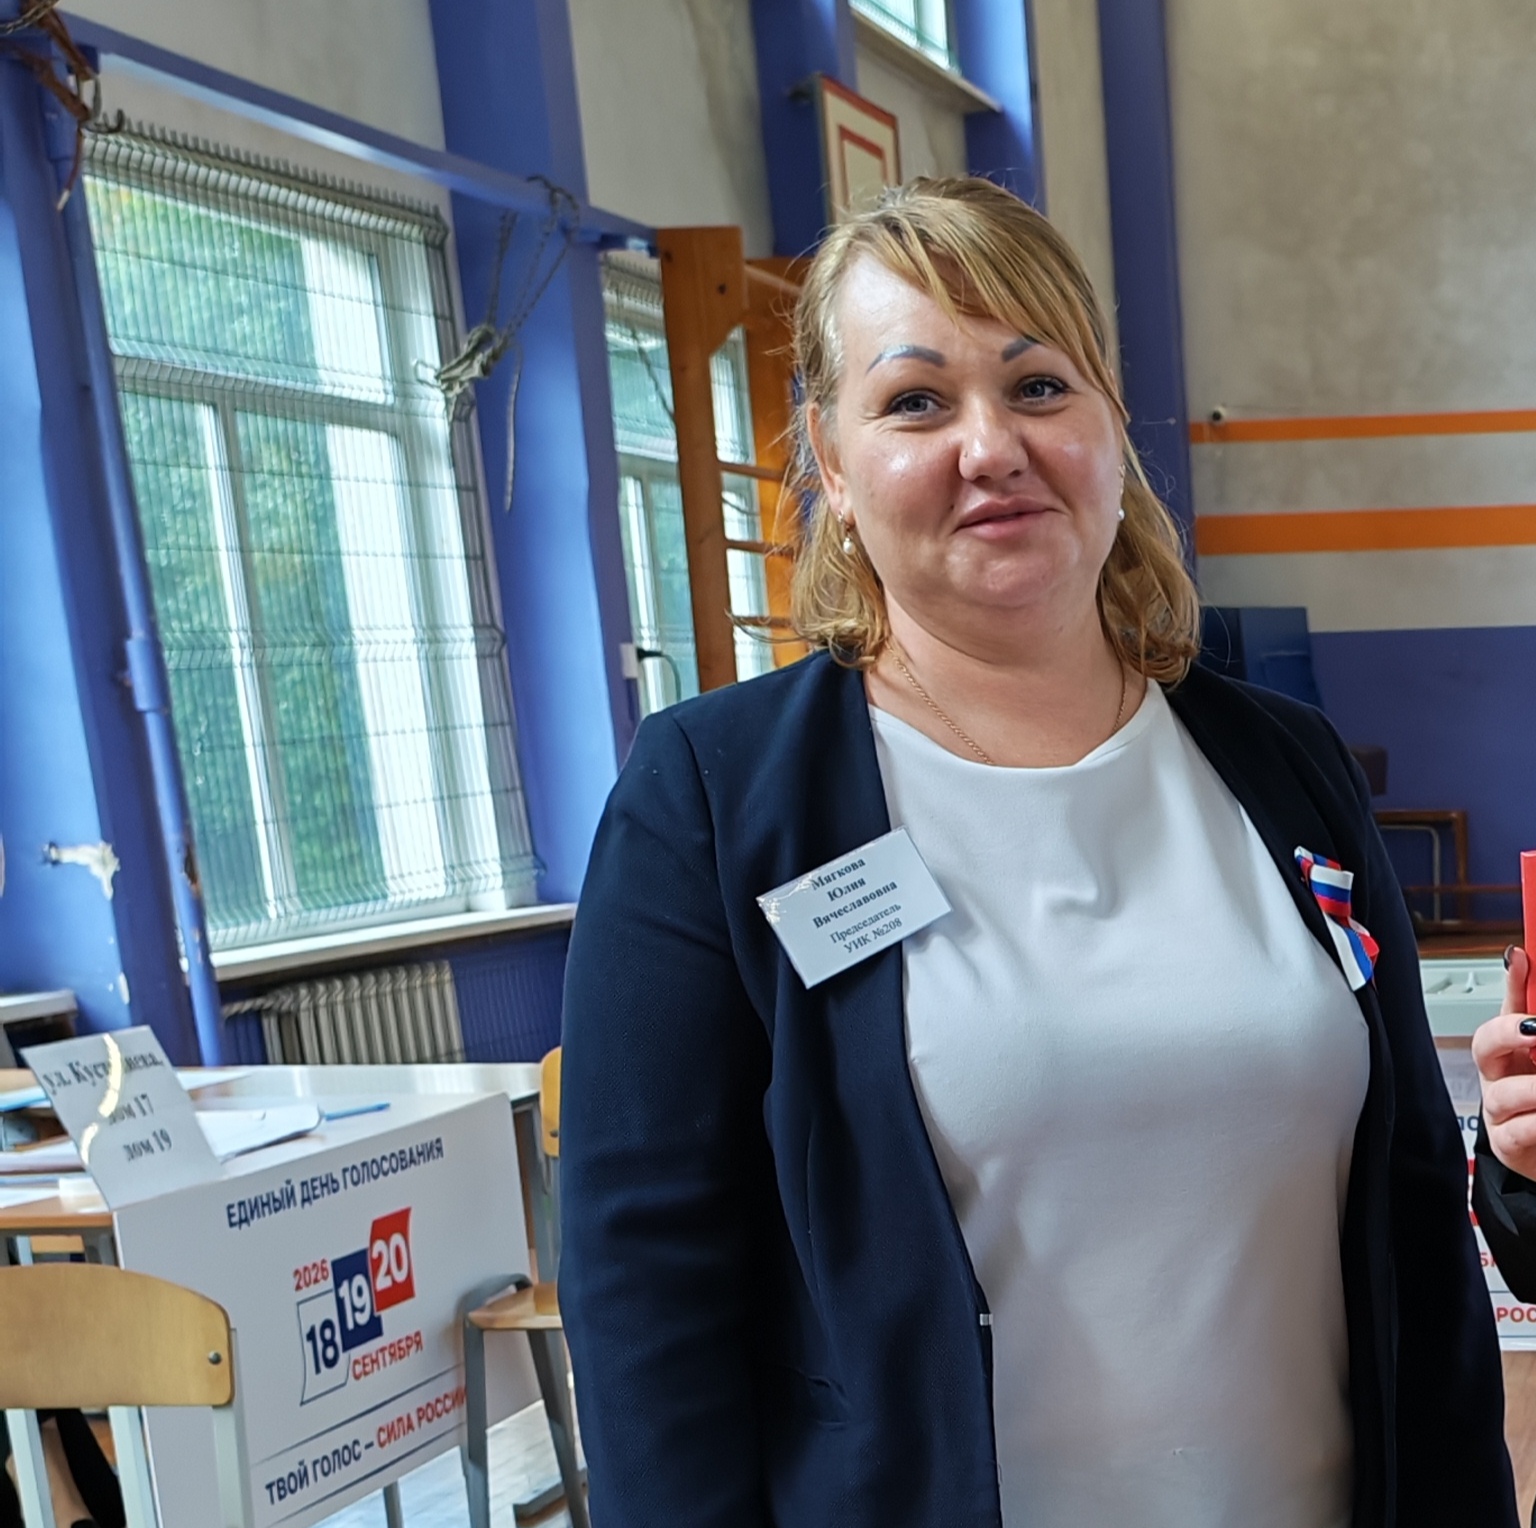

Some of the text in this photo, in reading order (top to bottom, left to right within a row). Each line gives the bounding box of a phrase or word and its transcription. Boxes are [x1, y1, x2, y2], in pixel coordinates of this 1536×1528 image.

[811, 859, 866, 890] Мягкова
[827, 878, 866, 901] Юлия
[812, 881, 898, 928] Вячеславовна
[830, 904, 901, 943] Председатель
[844, 917, 902, 953] УИК №208
[134, 1094, 155, 1117] 17
[123, 1128, 172, 1161] дом 19
[226, 1137, 444, 1230] ЕДИНЫЙ ДЕНЬ ГОЛОСОВАНИЯ
[293, 1258, 329, 1291] 2026
[306, 1232, 409, 1375] 18 19 20
[352, 1329, 423, 1381] СЕНТЯБРЯ
[265, 1459, 310, 1505] ТВОЙ
[312, 1438, 362, 1482] ГОЛОС
[377, 1412, 415, 1449] СИЛА
